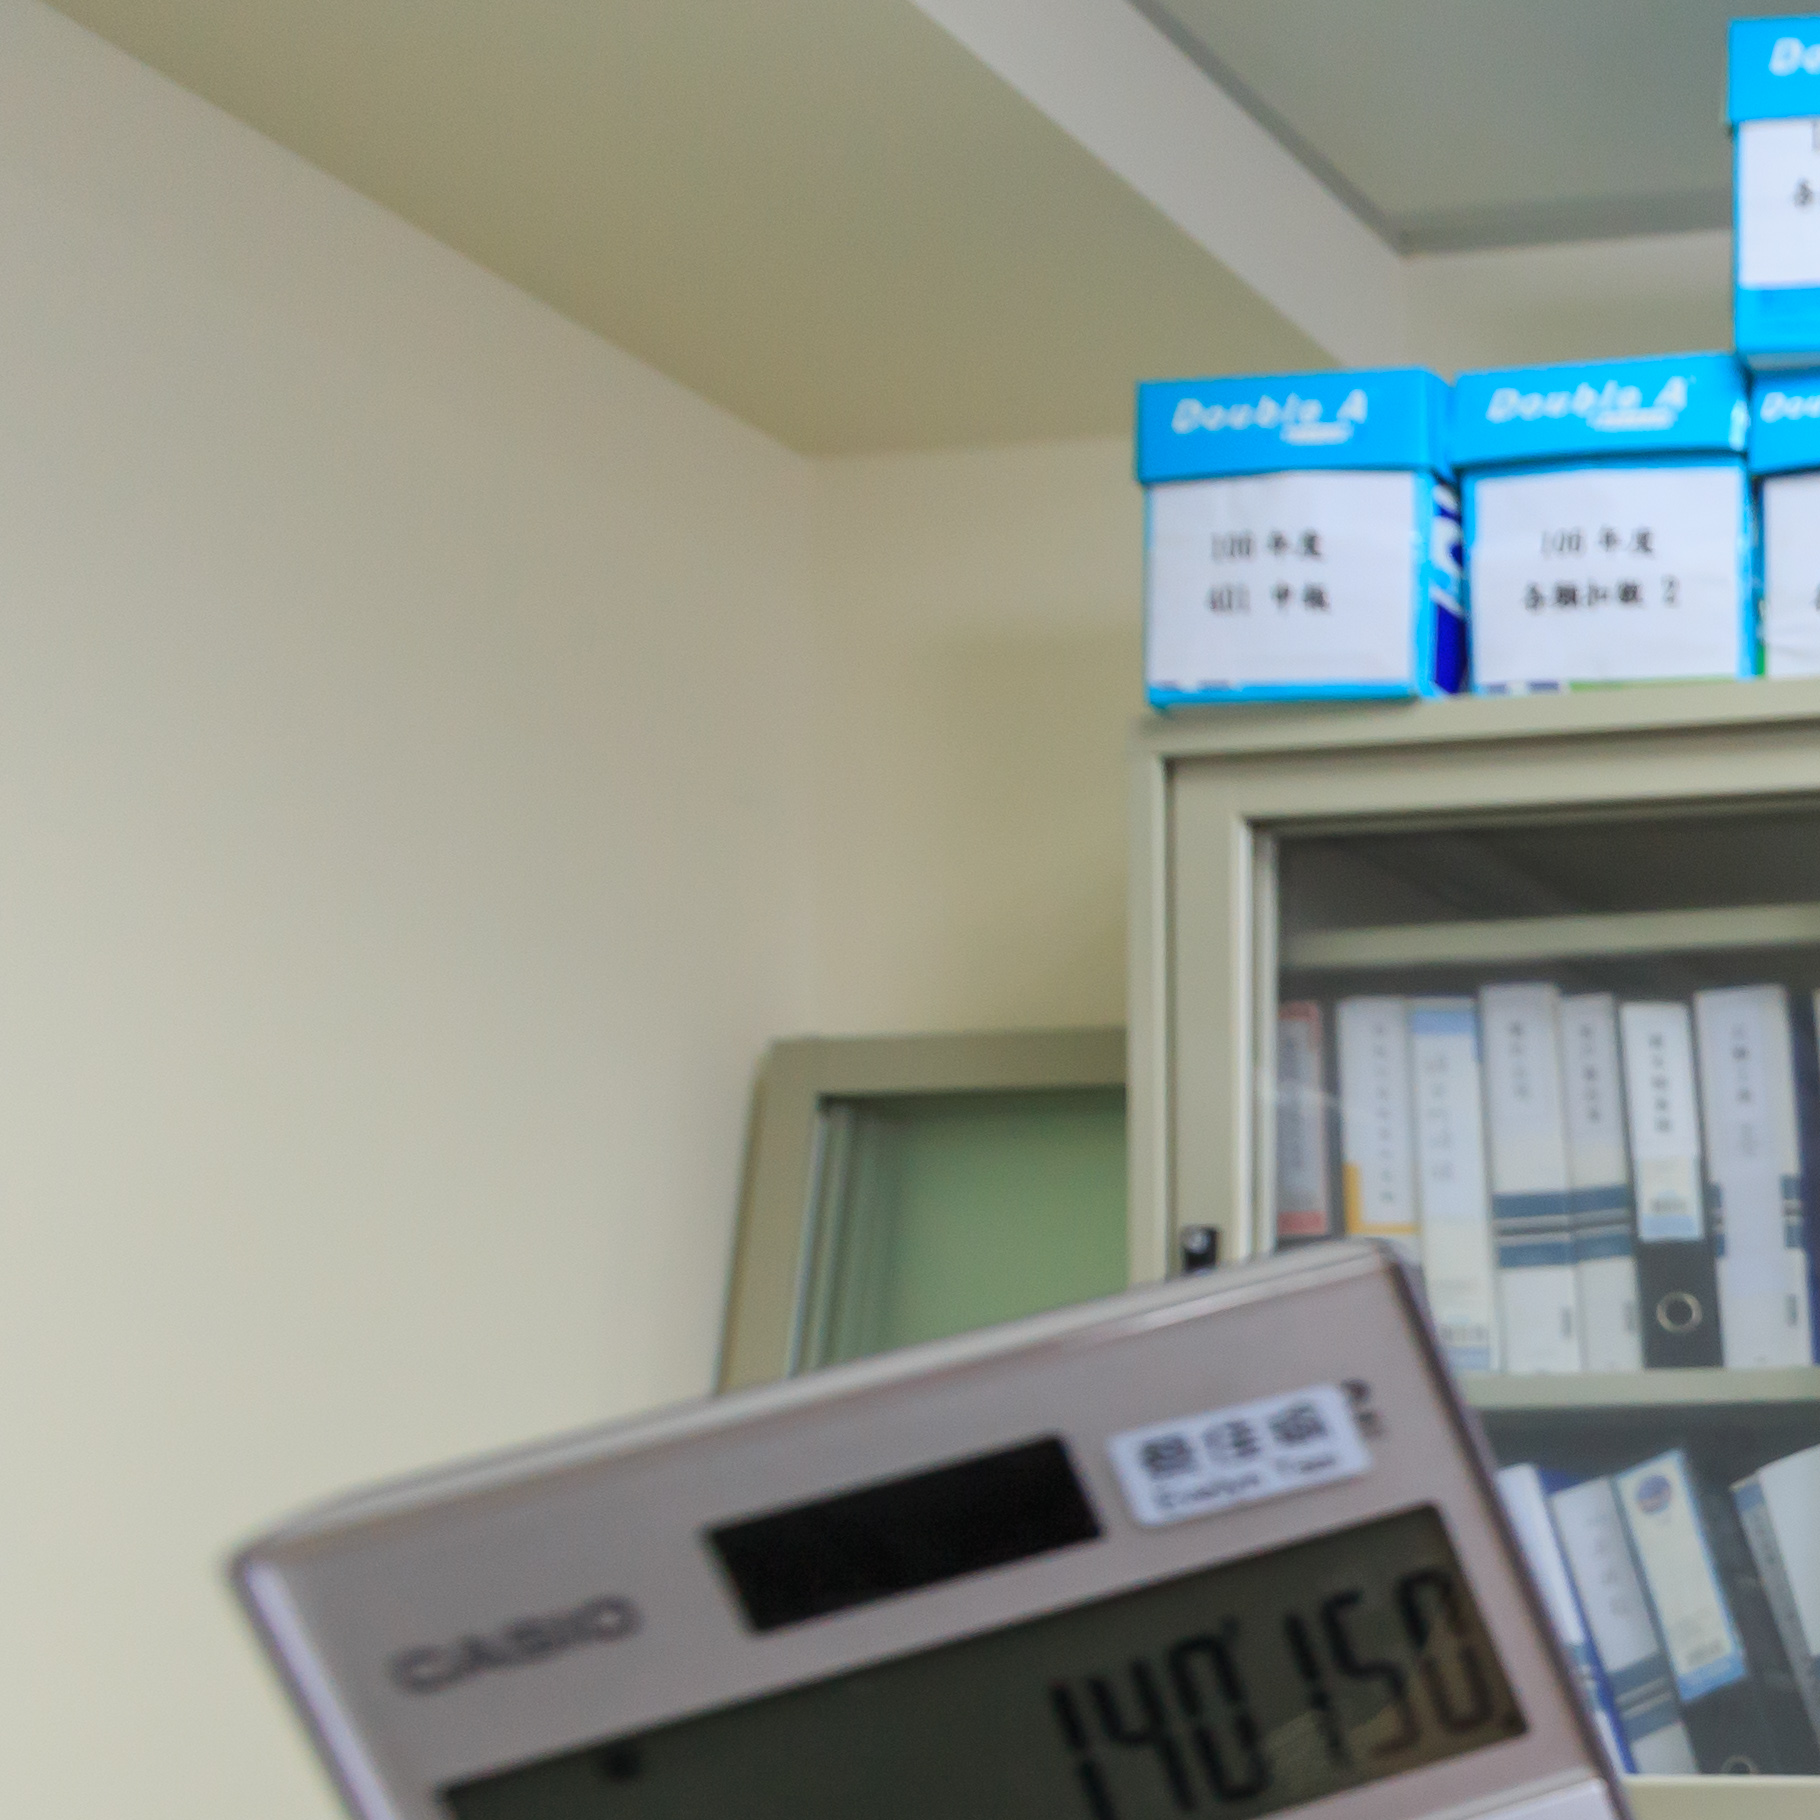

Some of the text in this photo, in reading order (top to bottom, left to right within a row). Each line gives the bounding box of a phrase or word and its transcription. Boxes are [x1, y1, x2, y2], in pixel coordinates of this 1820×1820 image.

[1171, 388, 1368, 435] Double A
[1485, 376, 1688, 425] Double A
[390, 1591, 645, 1694] CASIO
